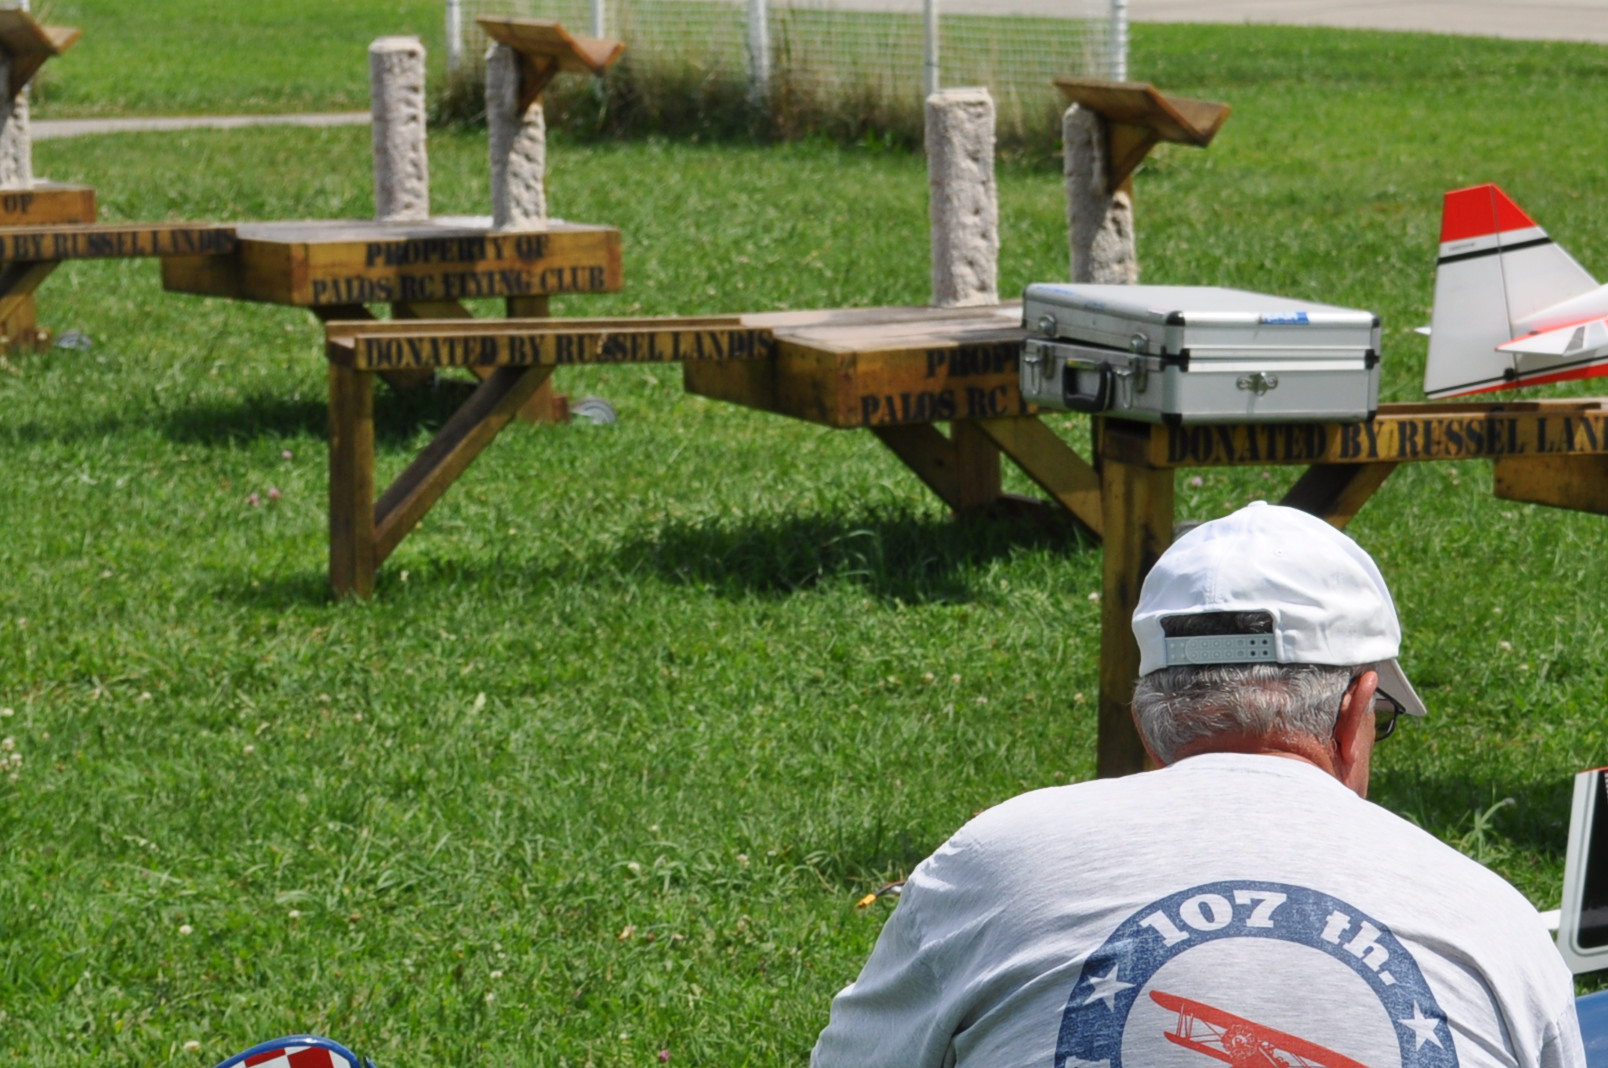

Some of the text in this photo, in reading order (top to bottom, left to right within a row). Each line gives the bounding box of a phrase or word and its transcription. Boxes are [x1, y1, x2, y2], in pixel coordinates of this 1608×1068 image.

[13, 232, 43, 259] BY
[365, 234, 547, 267] PROPERTY OF
[312, 266, 607, 305] PALOS RC FLYING CLUB
[365, 329, 774, 368] DONATED BY RUSSEL LANDIS
[859, 389, 955, 425] PALOS
[965, 384, 1009, 420] RC
[1167, 422, 1327, 464] DONATED
[1338, 418, 1384, 460] BY
[1398, 416, 1526, 459] RUSSEL
[1139, 889, 1400, 987] 107 th.
